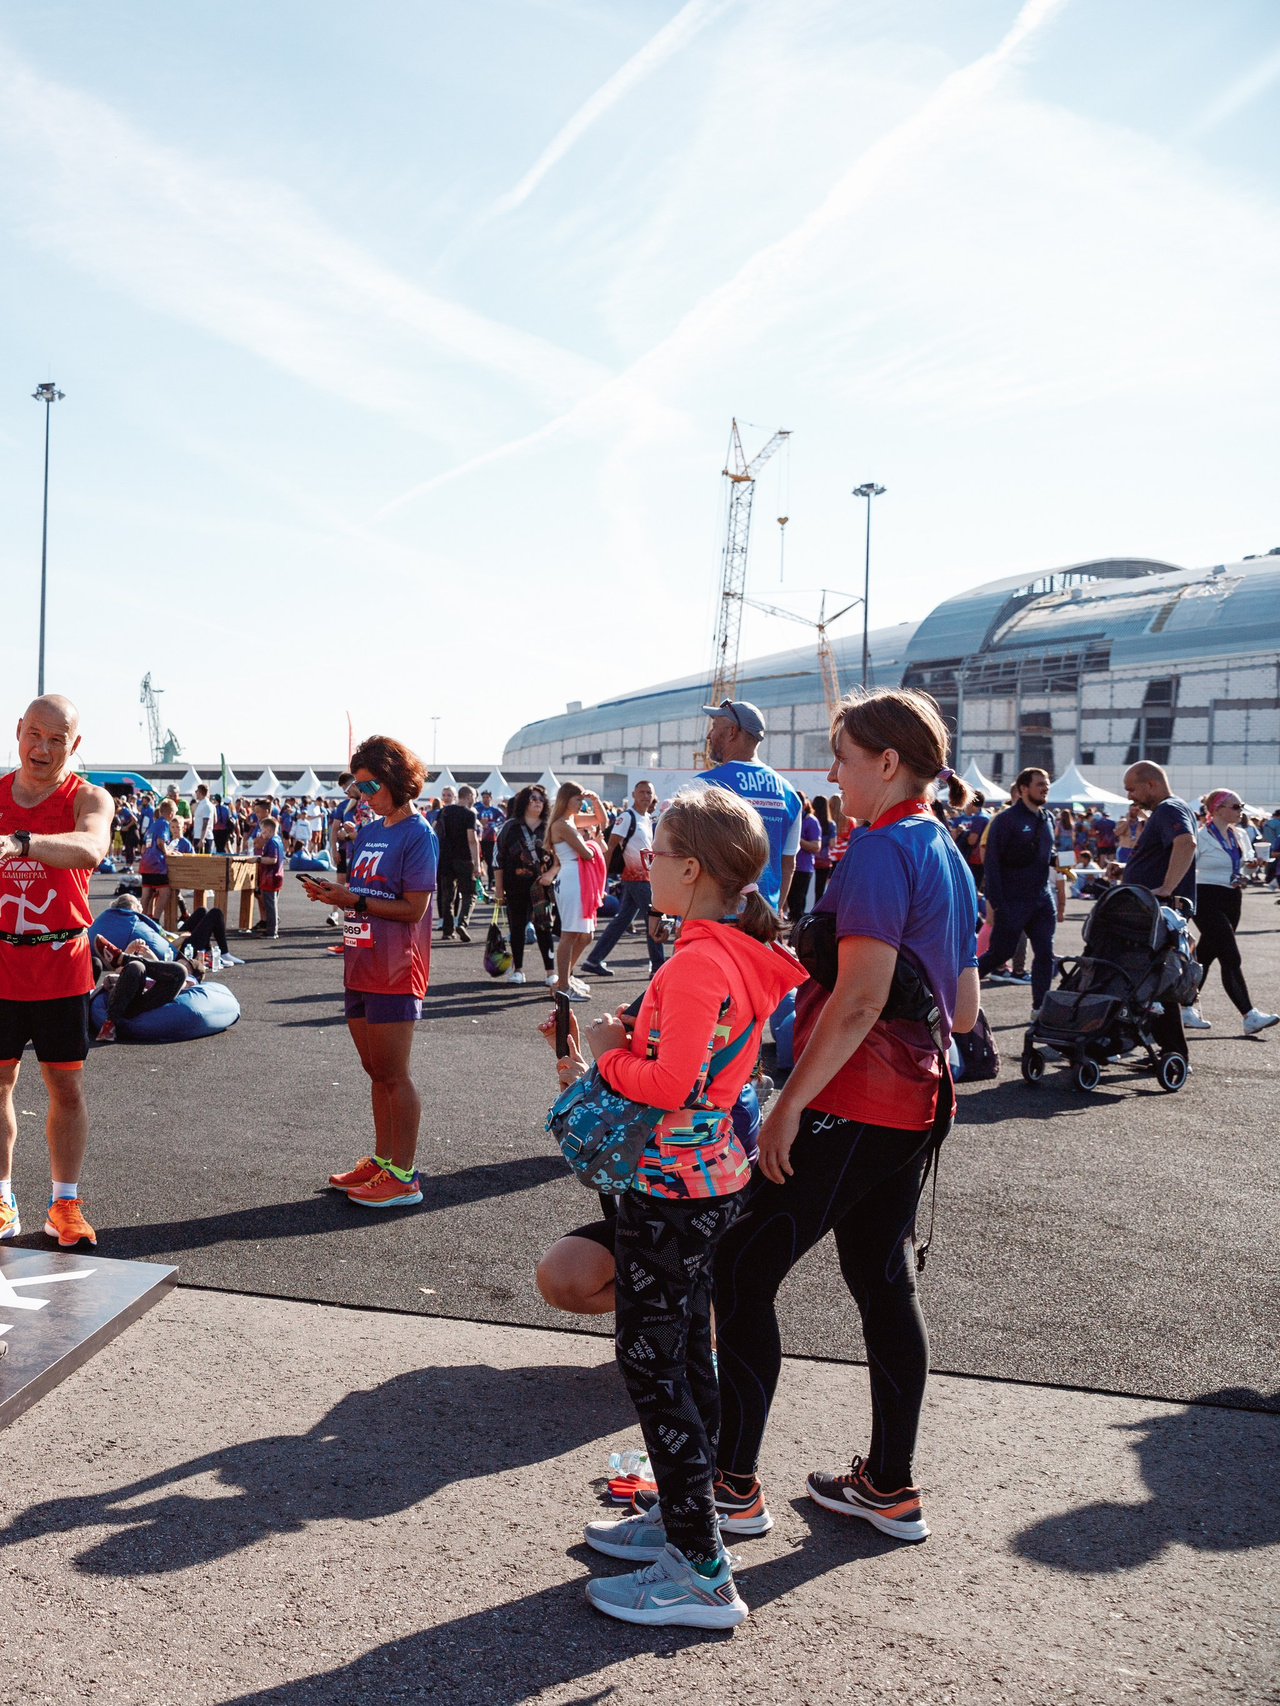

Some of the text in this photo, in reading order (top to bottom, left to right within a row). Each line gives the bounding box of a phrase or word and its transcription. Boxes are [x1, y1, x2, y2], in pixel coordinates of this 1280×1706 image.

[736, 771, 785, 797] ЗАРЯД
[700, 1213, 717, 1228] GIVE
[708, 1210, 720, 1220] UP
[691, 1217, 713, 1238] NEVER
[629, 1261, 640, 1272] UP
[630, 1268, 646, 1282] GIVE
[632, 1274, 656, 1292] NEVER
[627, 1347, 638, 1360] UP
[633, 1341, 647, 1360] GIVE
[638, 1335, 656, 1360] NEVER
[657, 1424, 668, 1436] UP
[661, 1428, 678, 1446] GIVE
[667, 1431, 690, 1455] NEVER
